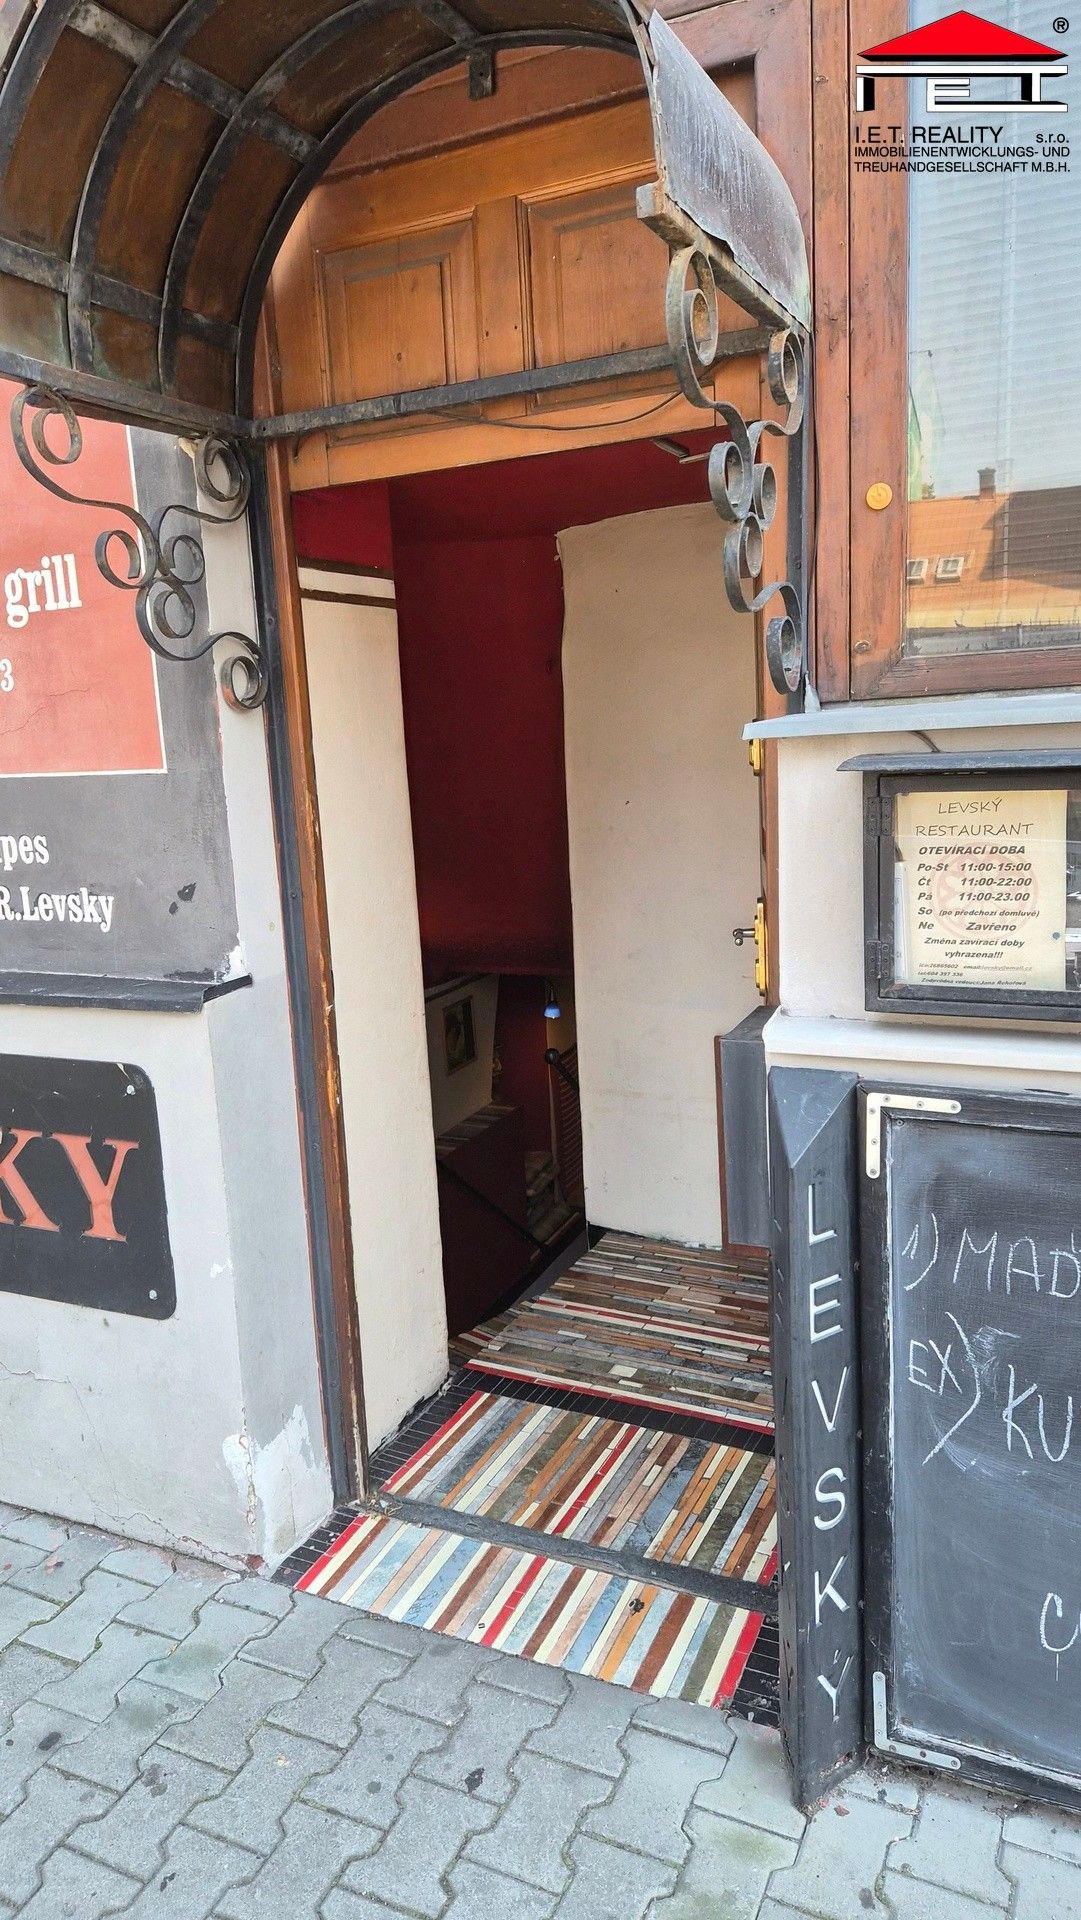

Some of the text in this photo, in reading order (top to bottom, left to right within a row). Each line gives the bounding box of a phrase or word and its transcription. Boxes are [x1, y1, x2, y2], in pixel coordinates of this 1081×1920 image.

[4, 553, 83, 629] grill
[938, 796, 1003, 815] LEVSKÝ
[915, 822, 1035, 837] RESTAURANT
[0, 834, 50, 871] pes
[918, 845, 1026, 855] OTEVÍRACÍ DOBA
[917, 862, 1032, 872] Po-St 11:00-15:00
[917, 876, 1032, 887] Čt 11:00-22:00
[917, 891, 933, 901] Pá
[917, 906, 933, 916] So
[918, 921, 1018, 932] Ne Zavřeno
[1000, 938, 1026, 948] doby
